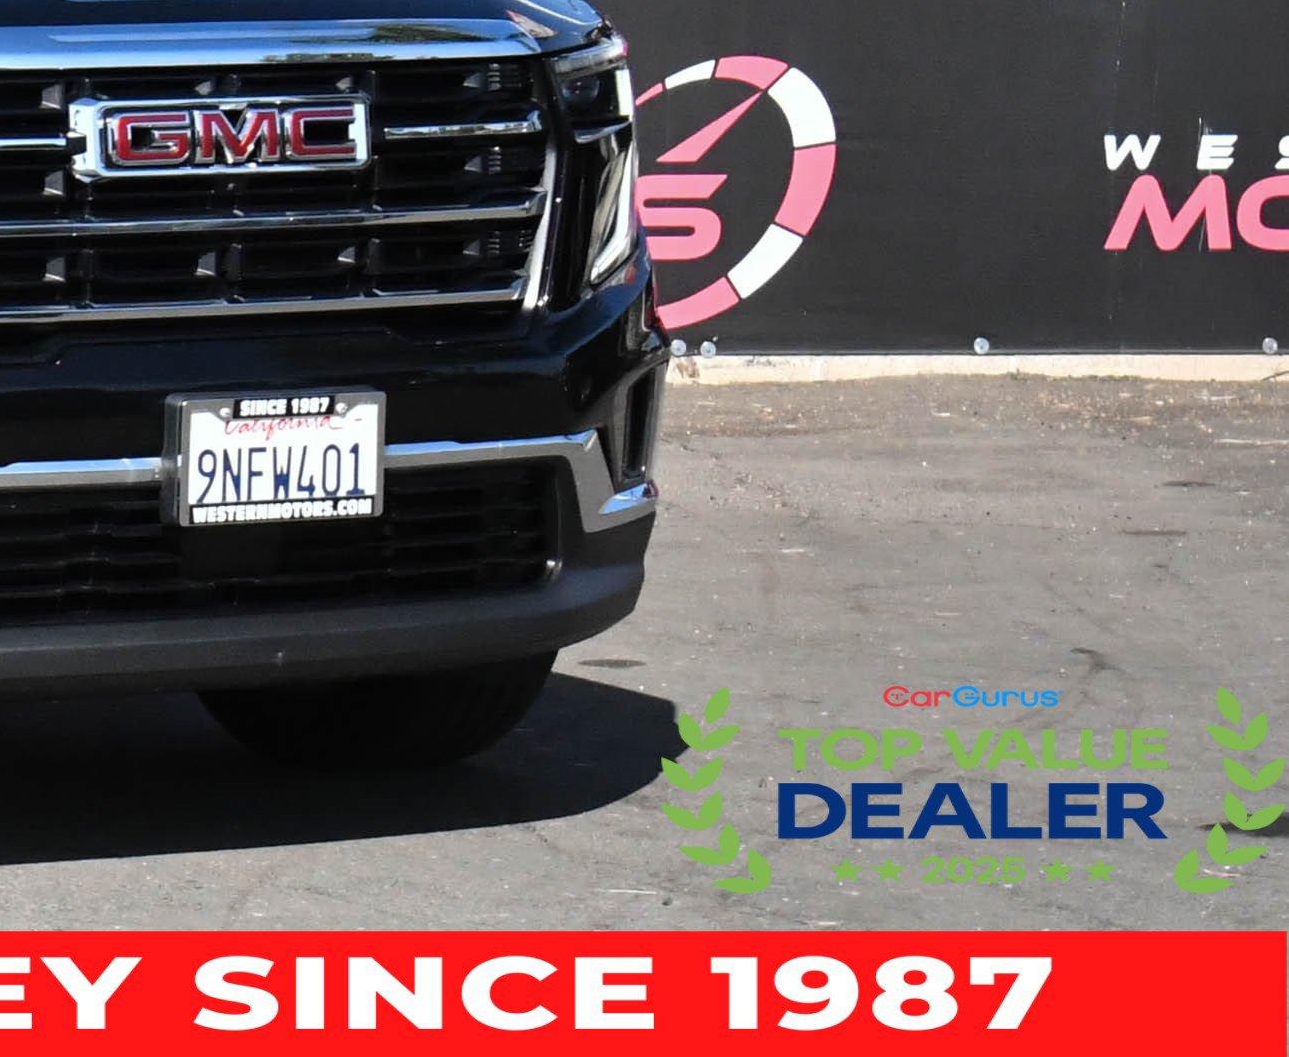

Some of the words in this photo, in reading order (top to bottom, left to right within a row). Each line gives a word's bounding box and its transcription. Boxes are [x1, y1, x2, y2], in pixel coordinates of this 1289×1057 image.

[112, 106, 358, 166] GMC
[240, 399, 287, 415] SINCE
[292, 398, 330, 413] 1987
[225, 415, 343, 441] California
[197, 443, 365, 503] 9NFW401
[193, 499, 372, 523] WESTERNMOTORS.COM
